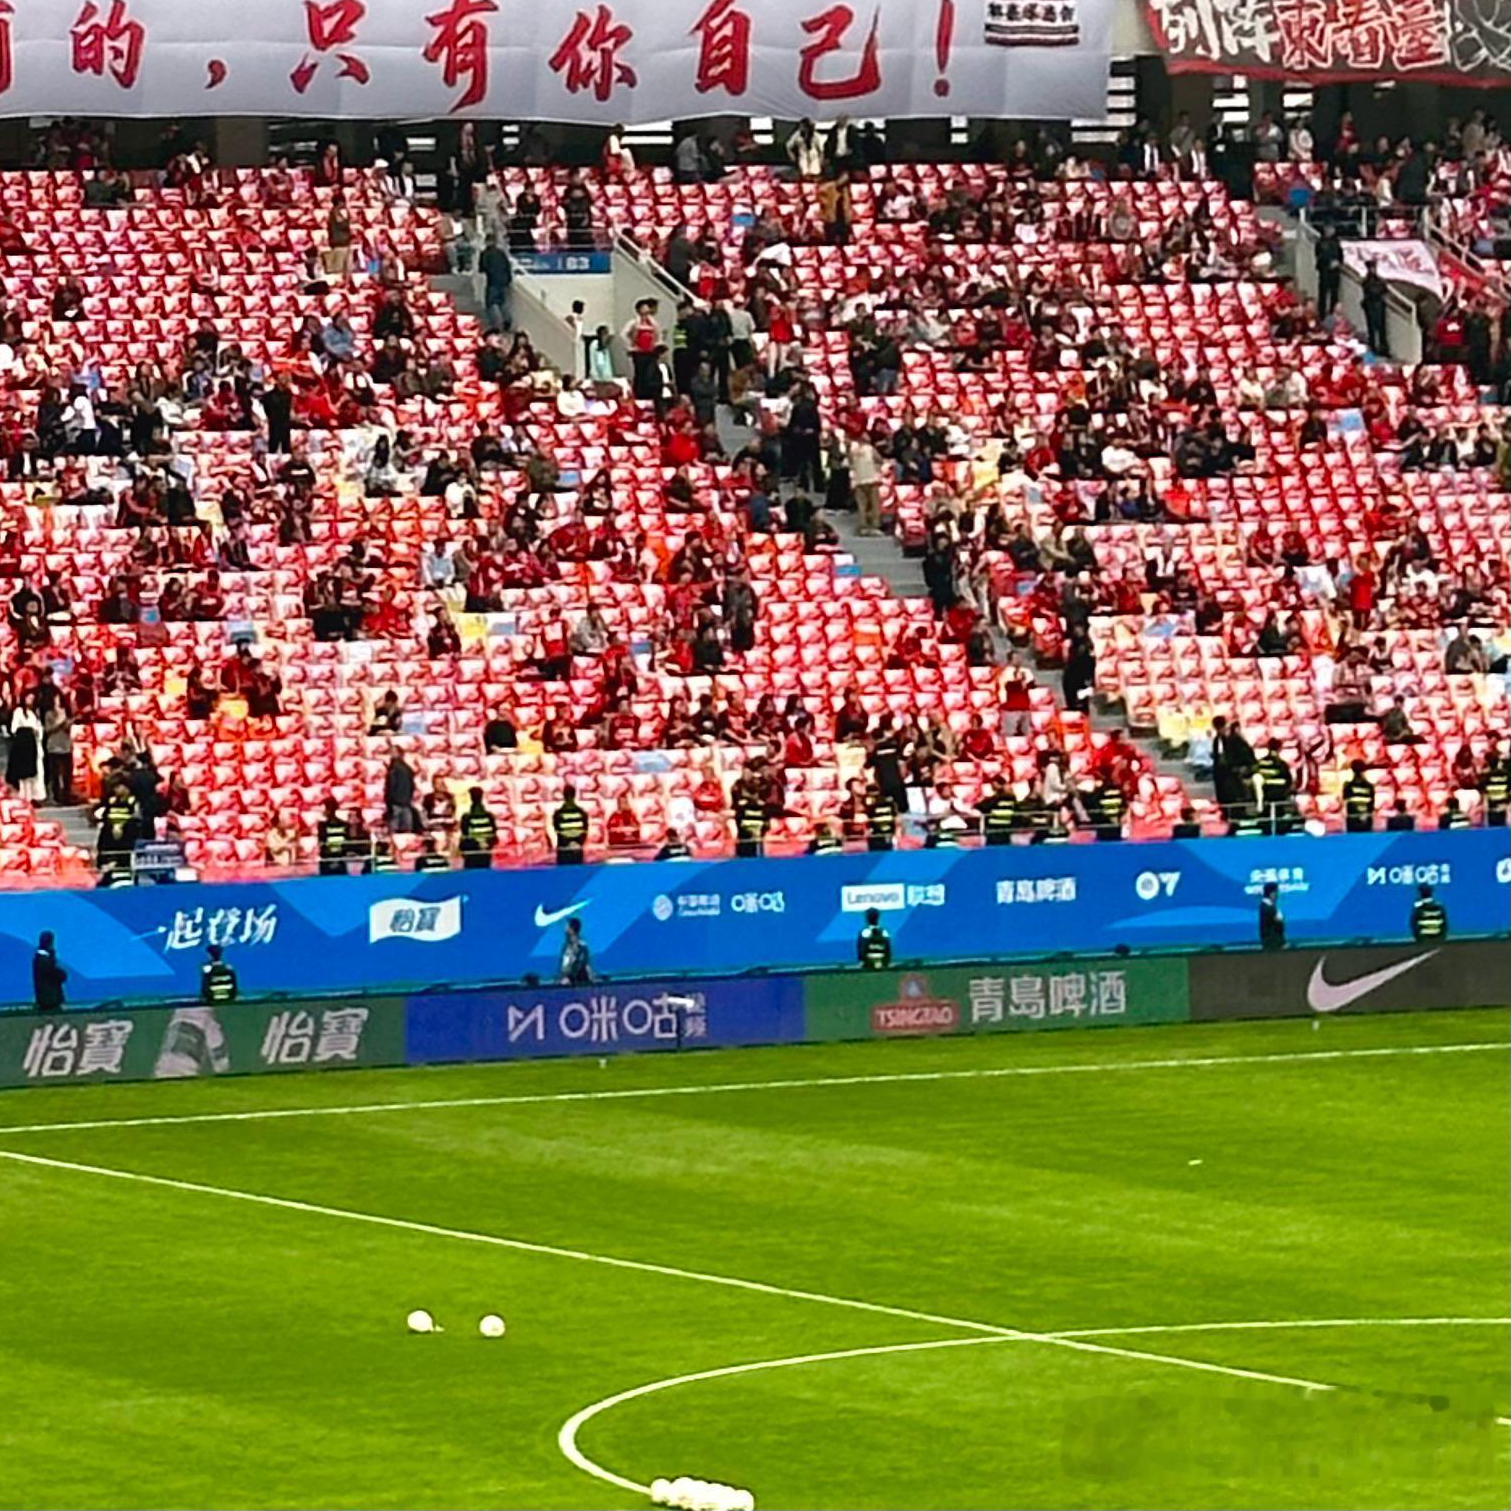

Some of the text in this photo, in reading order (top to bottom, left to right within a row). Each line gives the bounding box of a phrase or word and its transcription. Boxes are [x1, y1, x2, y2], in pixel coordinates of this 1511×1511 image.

[876, 1006, 955, 1027] TSINGTAO
[969, 970, 1127, 1024] 青島啤酒
[22, 1019, 133, 1078] 怡寶
[259, 1007, 370, 1065] 怡寶
